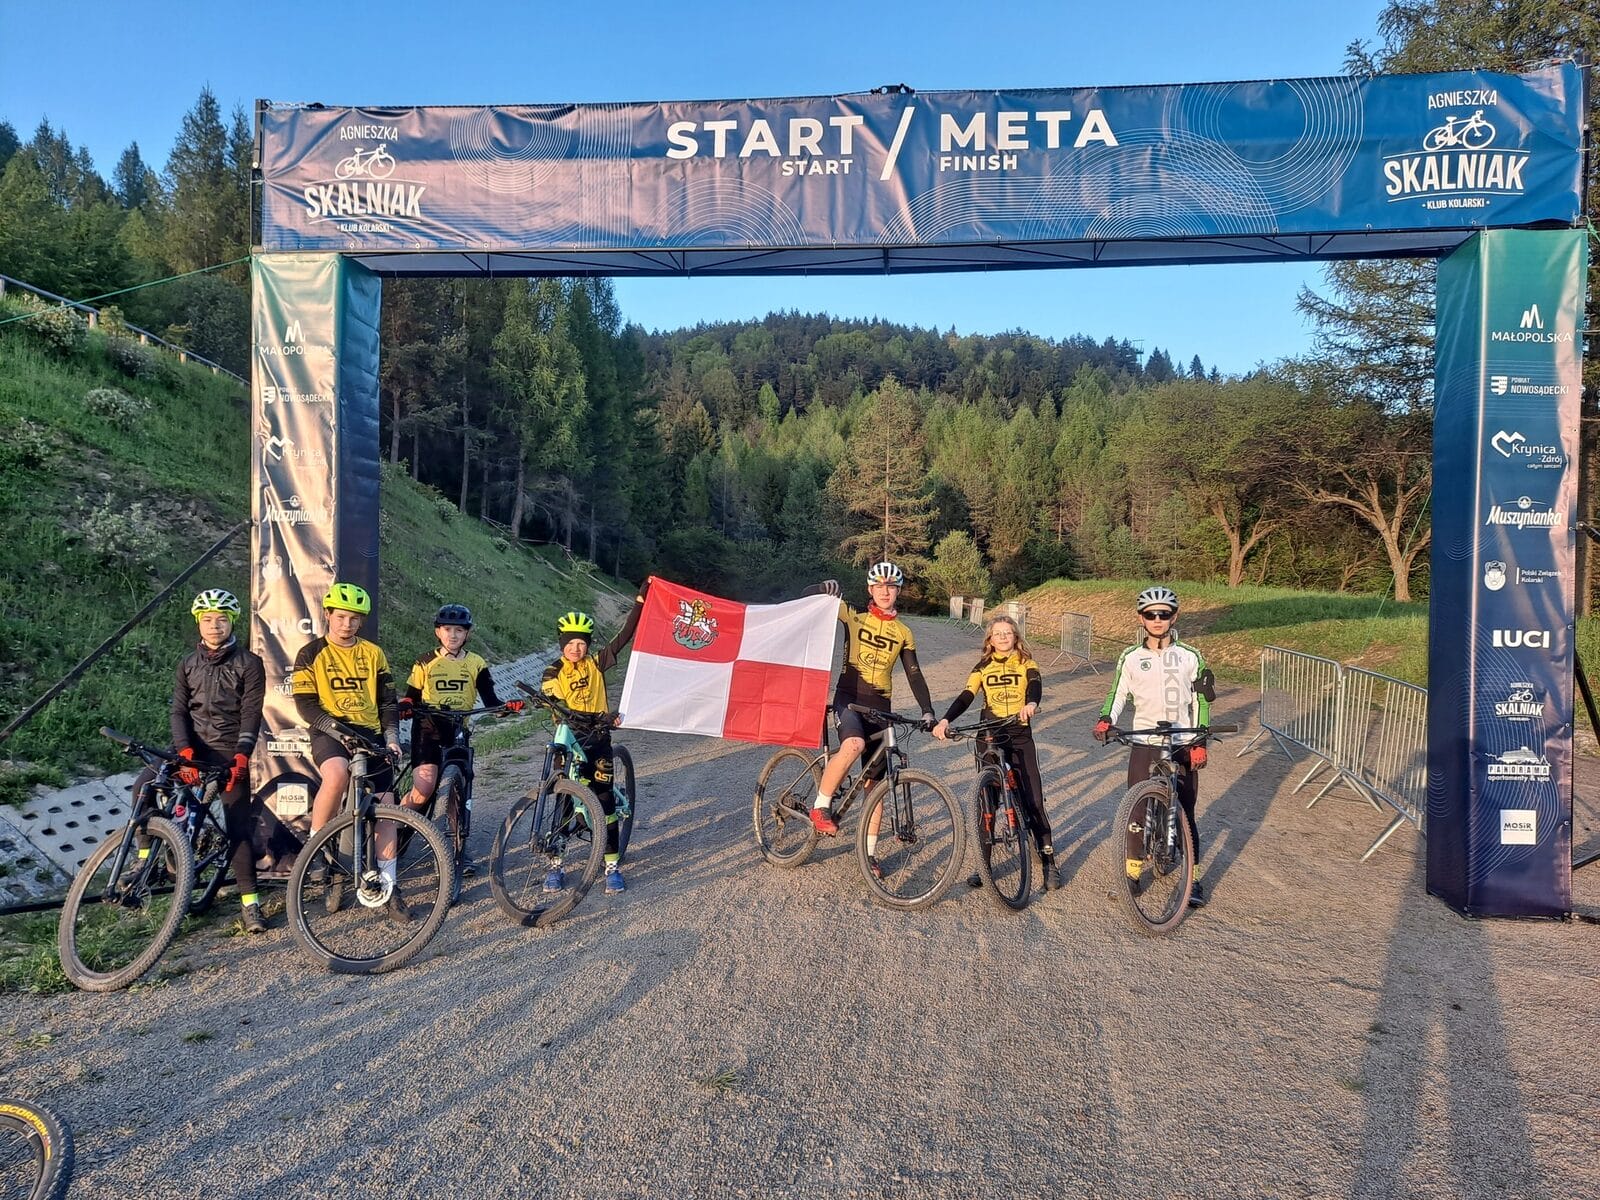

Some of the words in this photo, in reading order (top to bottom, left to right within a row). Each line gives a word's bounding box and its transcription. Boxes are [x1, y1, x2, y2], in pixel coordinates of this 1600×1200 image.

[1428, 90, 1497, 110] AGNIESZKA
[340, 125, 398, 141] AGNIESZKA
[666, 114, 864, 160] START
[940, 109, 1119, 153] META
[781, 159, 853, 176] START
[939, 154, 1018, 172] FINISH
[1384, 153, 1530, 196] SKALNIAK
[304, 182, 426, 218] SKALNIAK
[1427, 200, 1447, 209] KLUB
[1448, 198, 1485, 208] KOLARSKI
[341, 224, 358, 232] KLUB
[358, 223, 390, 233] KOLARSKI
[1491, 331, 1573, 343] MAŁOPOLSKA
[1510, 384, 1569, 396] NOWOSĄDECKI
[1512, 443, 1556, 457] Krynica
[1485, 505, 1562, 530] Muszynianka
[273, 685, 293, 696] SKAL
[1495, 702, 1545, 717] SKALNIAK
[1488, 765, 1549, 775] PANORAMA
[1, 1104, 49, 1136] SCORPION
